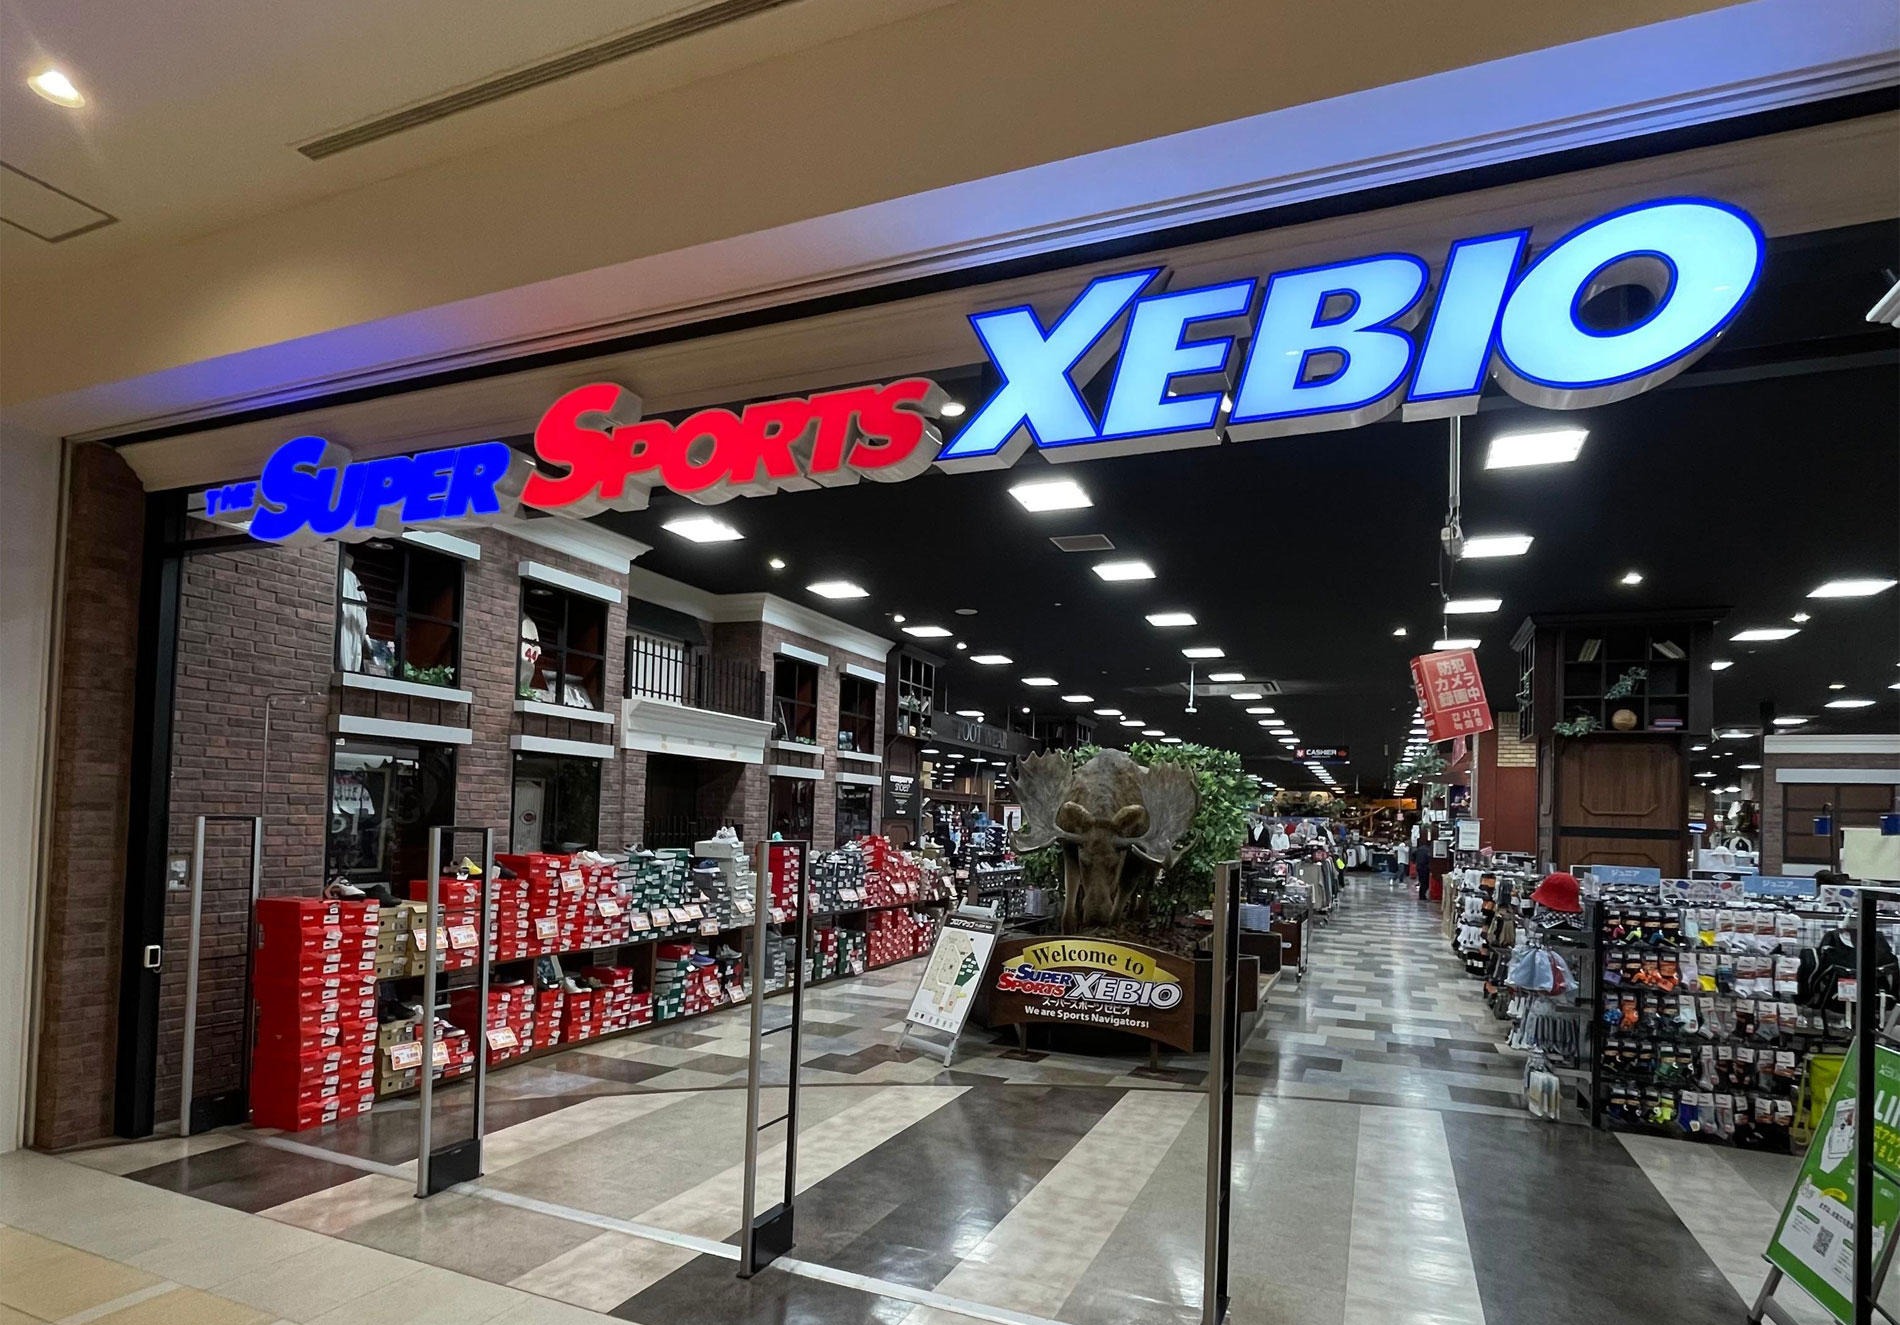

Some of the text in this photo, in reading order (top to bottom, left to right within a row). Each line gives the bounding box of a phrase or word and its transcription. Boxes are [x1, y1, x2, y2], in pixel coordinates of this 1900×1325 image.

[206, 195, 1768, 540] THE SUPER SPORTS XEBIO
[1434, 672, 1476, 692] カメラ
[1611, 869, 1640, 878] ジュニア
[1762, 879, 1794, 888] ジュニア
[1031, 944, 1145, 976] Welcome to
[995, 972, 1067, 998] SPORTS
[1016, 963, 1074, 986] SUPER
[1064, 971, 1183, 1010] XEBIO
[1024, 1005, 1150, 1029] We are Sports Navigators!
